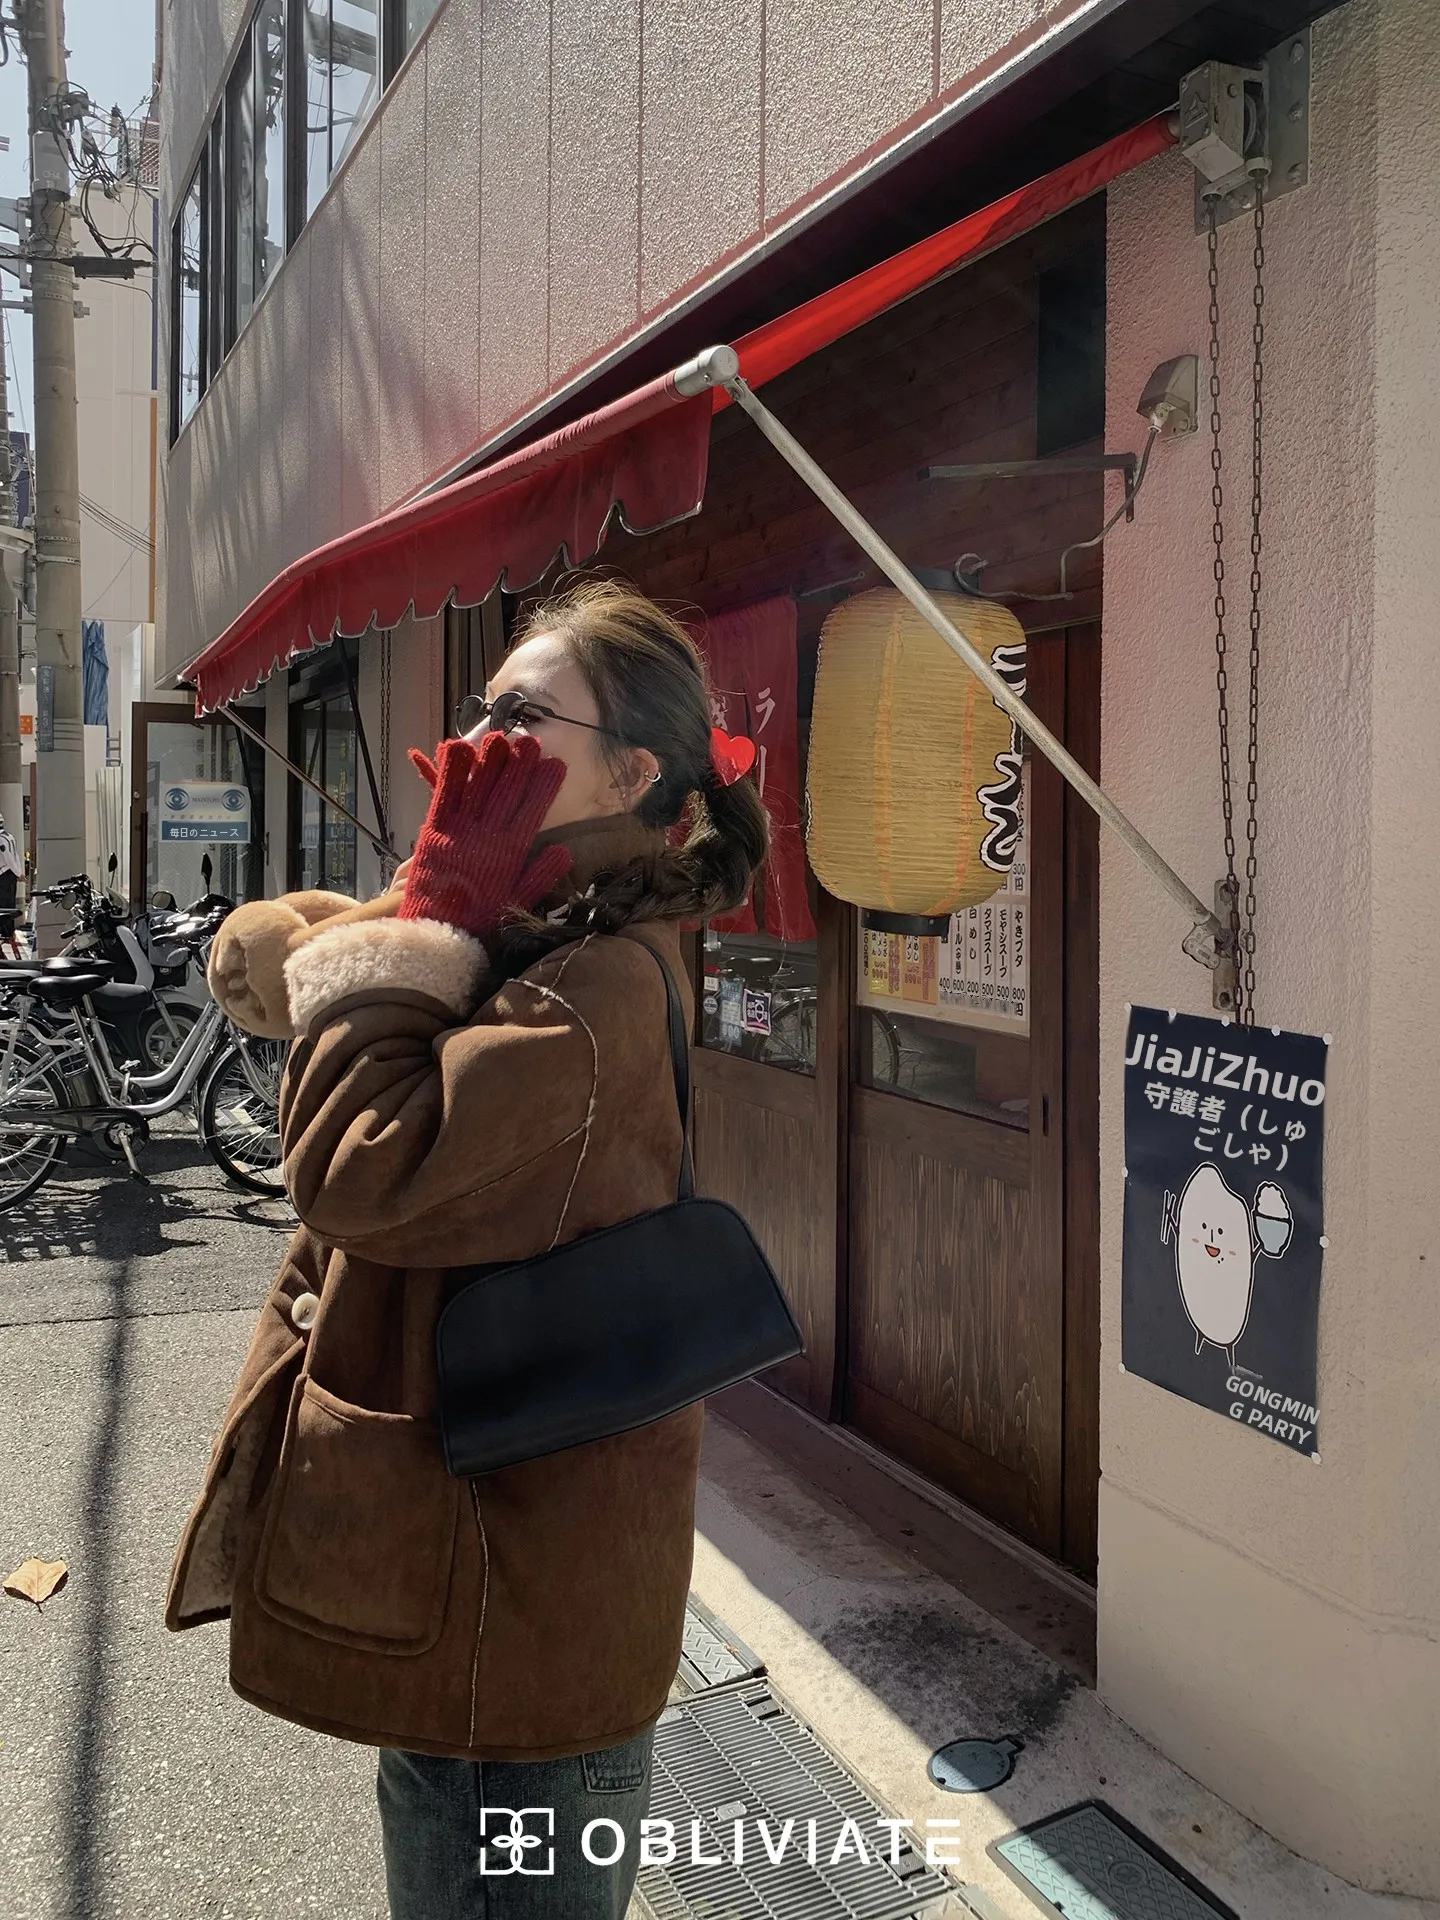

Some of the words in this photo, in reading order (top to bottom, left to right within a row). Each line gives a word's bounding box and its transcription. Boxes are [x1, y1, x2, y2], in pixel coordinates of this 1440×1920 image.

[170, 827, 239, 838] 毎日のニュース
[1125, 1033, 1326, 1107] JiaJiZhuo
[1225, 1375, 1320, 1425] GONGMIN
[1229, 1402, 1244, 1419] G
[1247, 1408, 1313, 1445] PARTY
